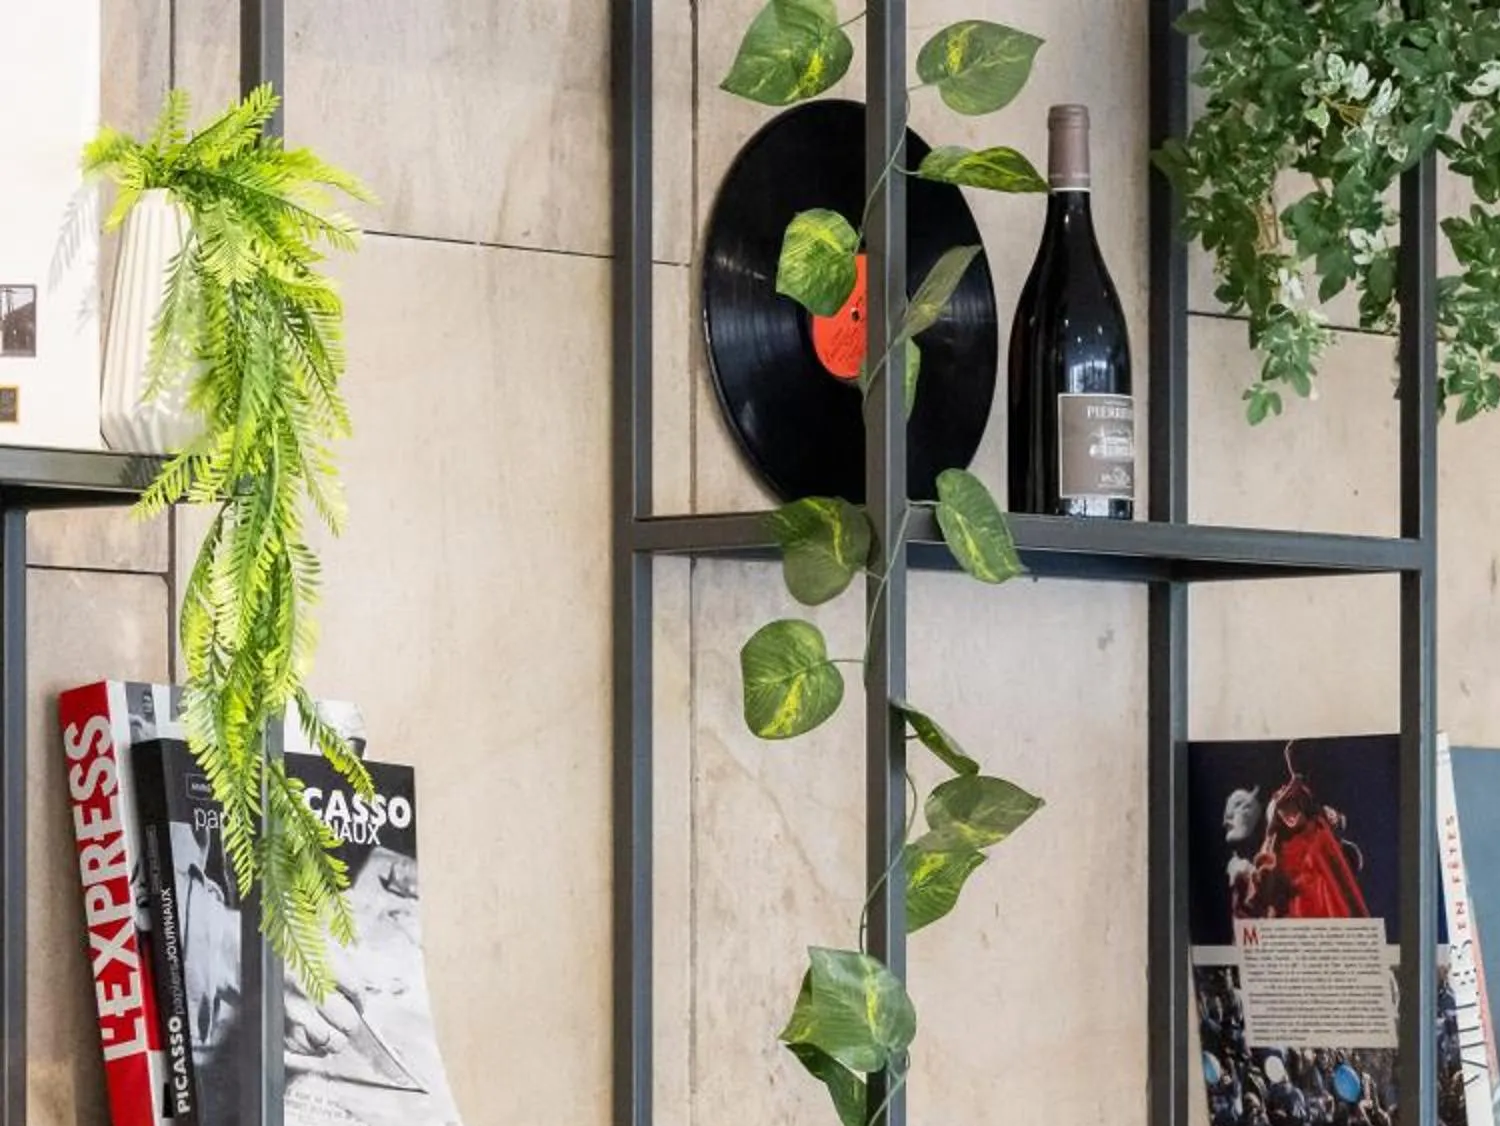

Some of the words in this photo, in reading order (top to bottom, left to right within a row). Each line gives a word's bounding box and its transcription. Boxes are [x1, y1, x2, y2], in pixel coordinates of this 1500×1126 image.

[303, 786, 412, 829] CASSO
[64, 715, 149, 1063] L'EXPRESS
[168, 1016, 191, 1113] PICASSO
